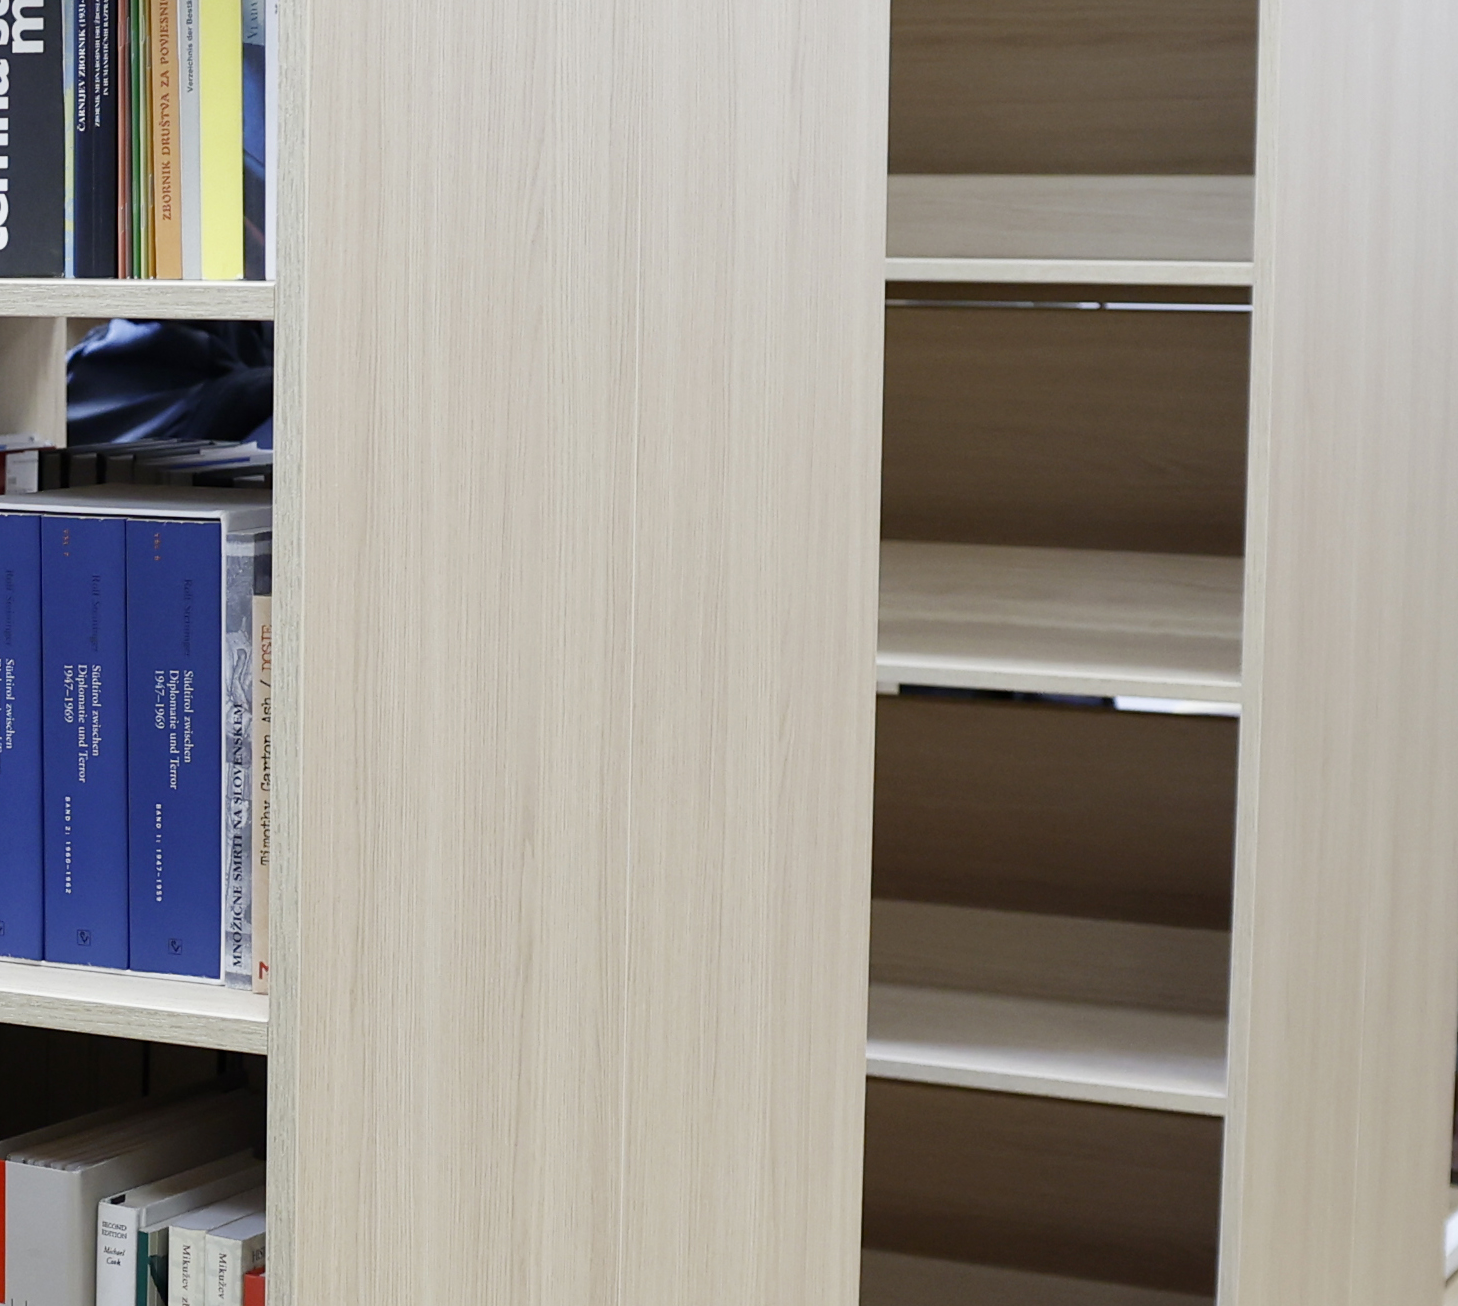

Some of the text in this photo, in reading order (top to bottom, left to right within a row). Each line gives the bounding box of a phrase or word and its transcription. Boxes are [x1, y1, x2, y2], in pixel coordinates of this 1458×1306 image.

[161, 70, 169, 88] ZA
[157, 93, 171, 156] DRUŠTVA
[162, 161, 172, 221] ZBORNIK
[5, 658, 16, 749] Südtirol zwischen
